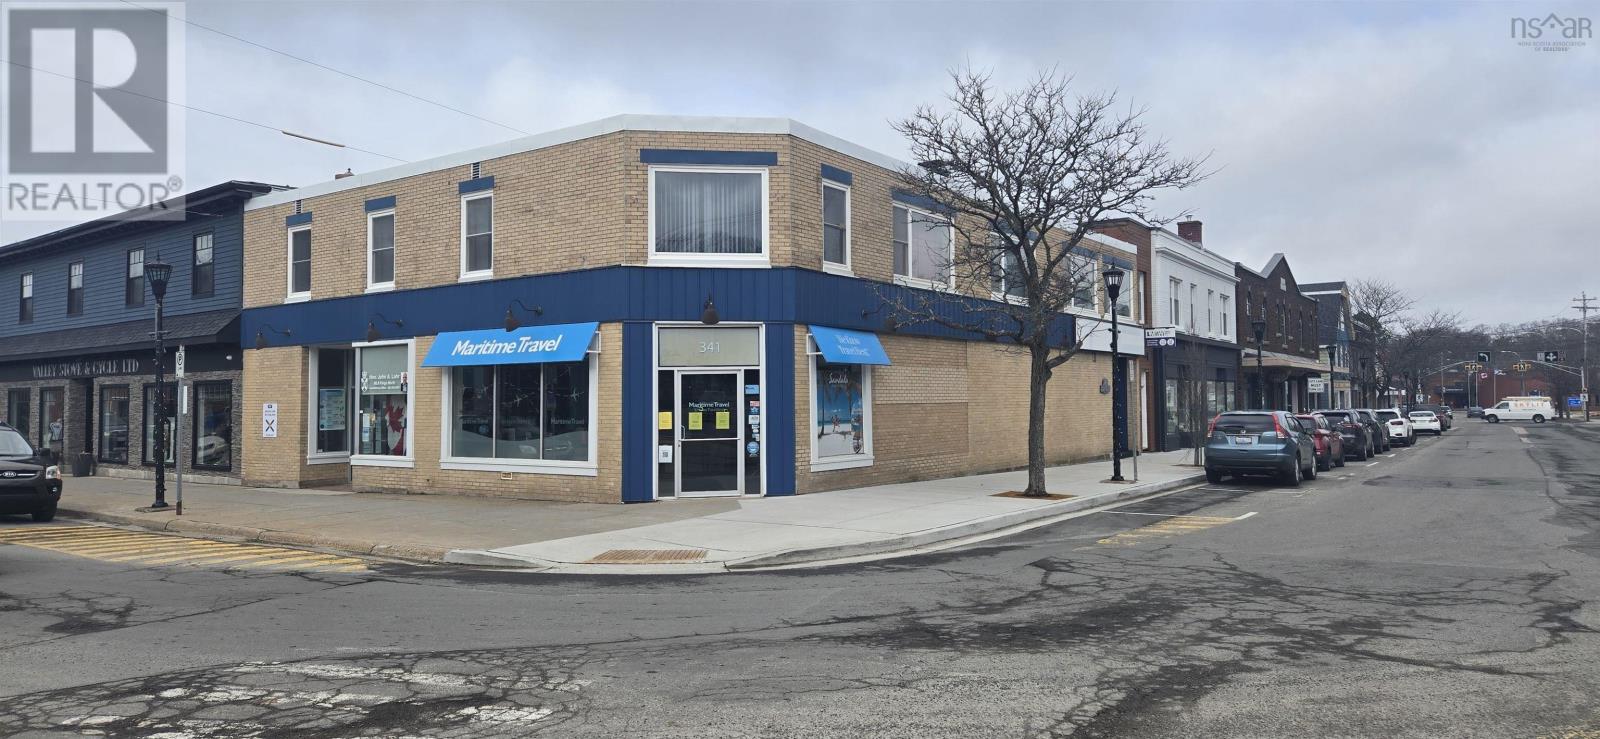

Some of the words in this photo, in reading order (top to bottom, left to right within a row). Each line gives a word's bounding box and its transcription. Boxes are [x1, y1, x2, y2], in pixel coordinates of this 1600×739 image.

[451, 340, 516, 356] Maritime
[518, 335, 563, 353] Travel
[699, 342, 720, 353] 341
[32, 364, 56, 378] VALLEY
[59, 362, 82, 377] STOVE
[84, 361, 91, 375] &
[93, 360, 118, 374] CYCLE
[123, 359, 139, 373] LTD
